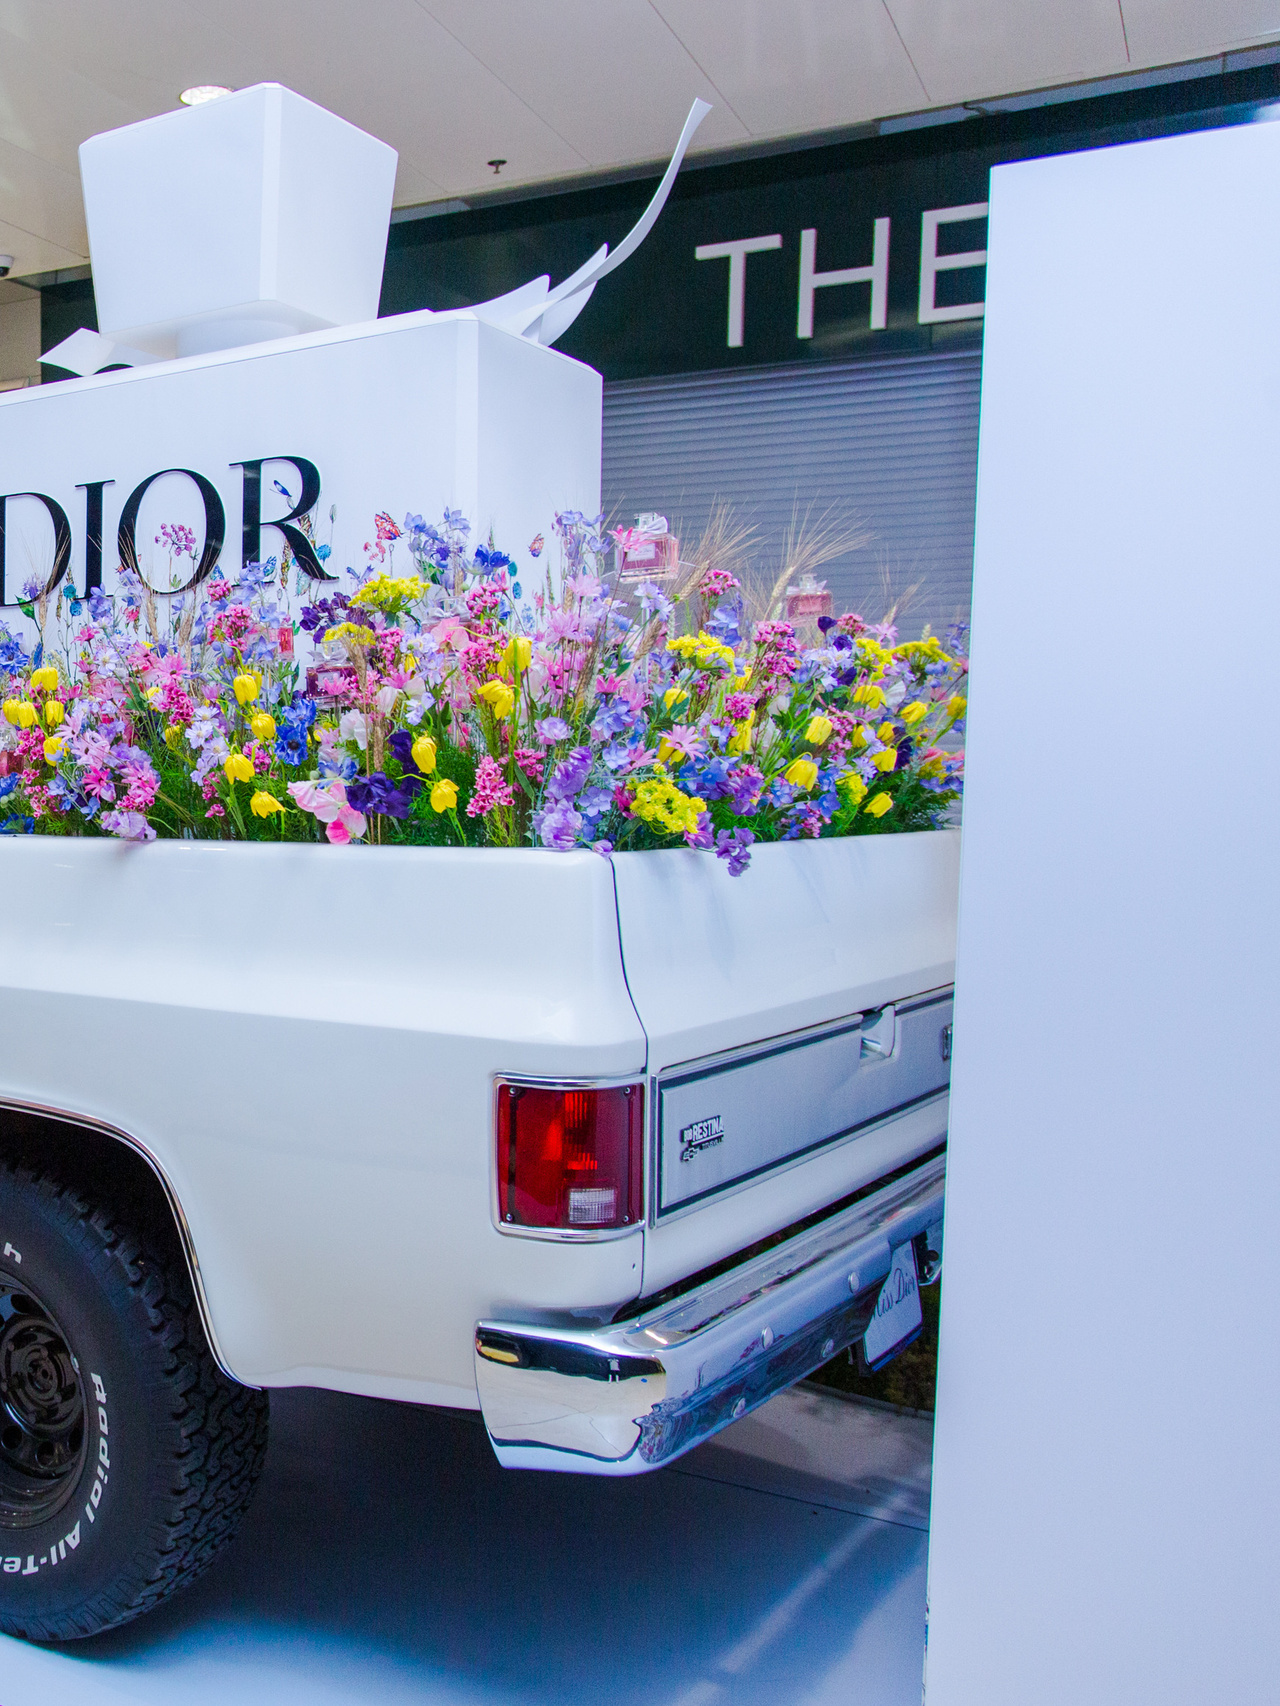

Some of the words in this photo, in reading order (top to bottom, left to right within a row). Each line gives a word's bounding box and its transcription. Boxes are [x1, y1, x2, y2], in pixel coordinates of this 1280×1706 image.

[695, 201, 989, 348] THE
[894, 1267, 916, 1304] Dior
[84, 1372, 111, 1523] Radial
